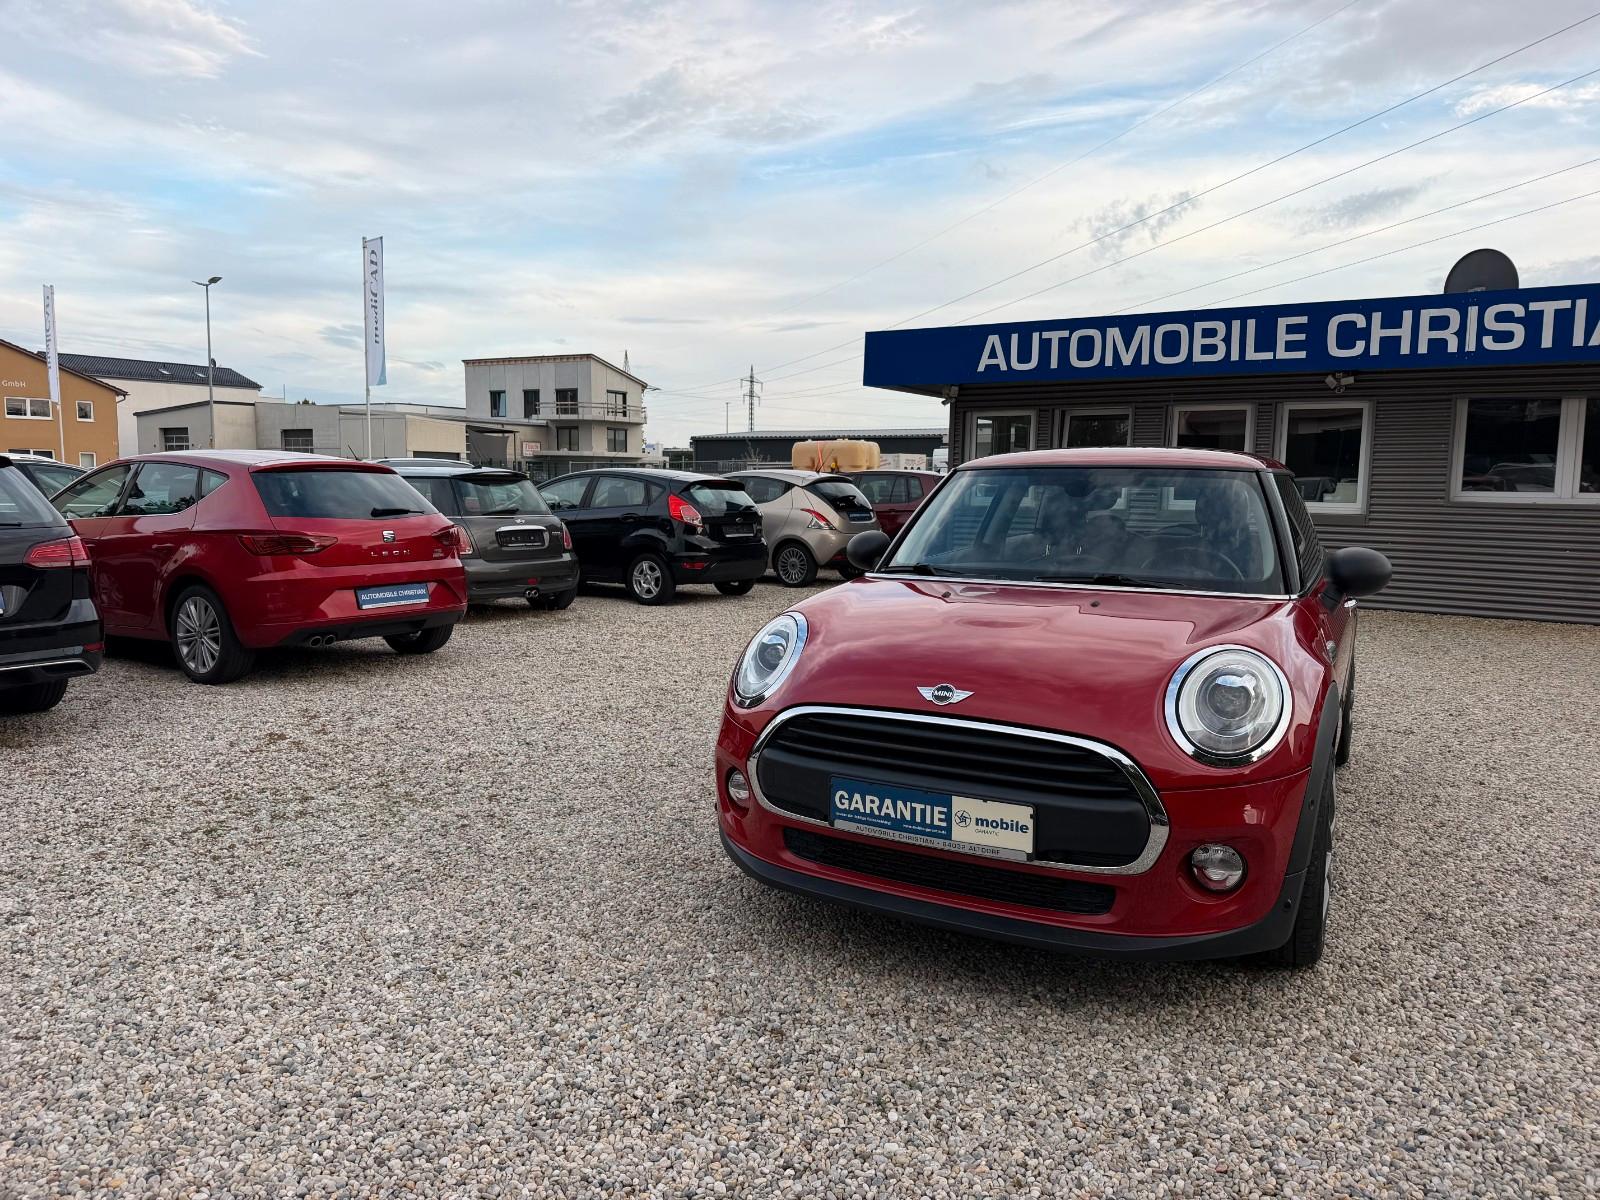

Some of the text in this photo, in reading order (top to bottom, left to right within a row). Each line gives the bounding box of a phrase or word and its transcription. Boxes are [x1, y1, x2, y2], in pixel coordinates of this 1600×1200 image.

[976, 298, 1600, 373] AUTOMOBILE CHRISTI
[1, 379, 26, 388] GmbH
[361, 588, 426, 600] AUTOMOBILE CHRISTIAN
[933, 690, 953, 698] MINI
[834, 790, 948, 827] GARANTIE
[975, 816, 1030, 834] mobile
[855, 825, 896, 839] AUTOMOBILE
[898, 833, 935, 845] CHRISTIAN
[968, 845, 1001, 856] ALTDORF
